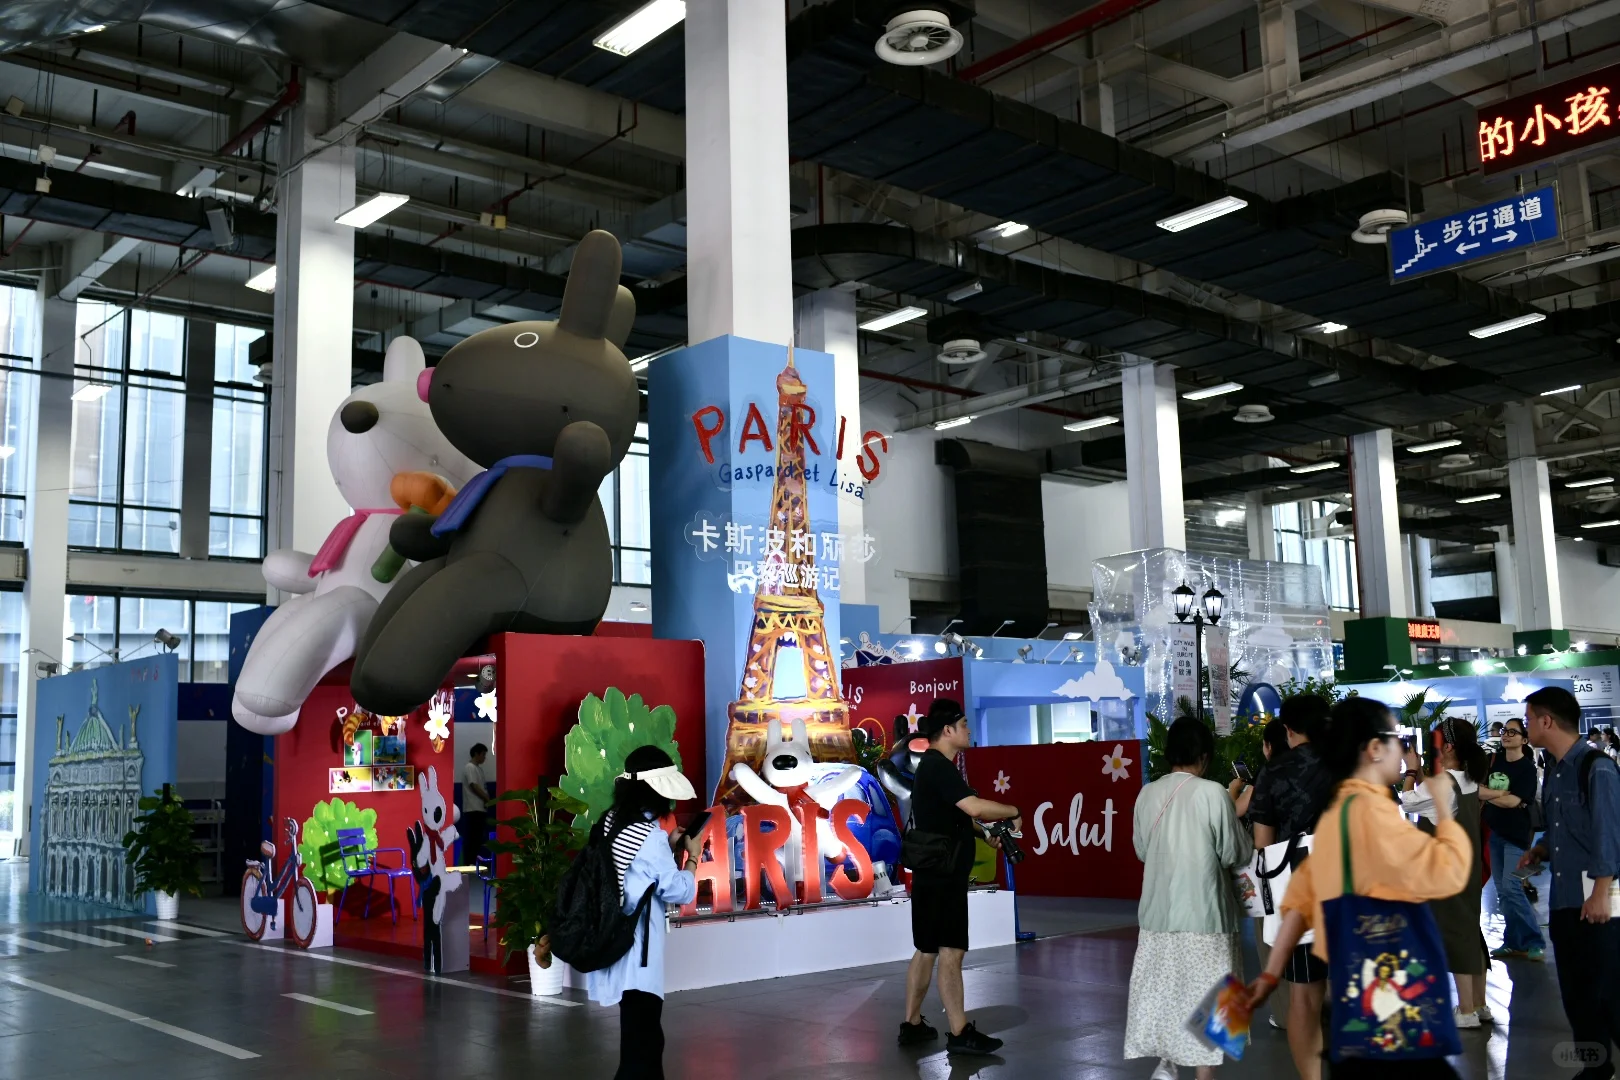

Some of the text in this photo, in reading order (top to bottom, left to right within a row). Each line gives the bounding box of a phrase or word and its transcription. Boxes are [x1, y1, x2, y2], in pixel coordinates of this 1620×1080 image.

[1479, 86, 1620, 162] 的小孩
[1443, 196, 1542, 244] 步行通道
[691, 402, 888, 481] PARIS
[718, 461, 865, 500] Gaspard et Lisa
[692, 519, 876, 563] 卡斯波和丽莎
[1178, 660, 1191, 668] 印象
[840, 684, 864, 704] IS
[910, 677, 959, 699] Bonjour
[1032, 792, 1118, 856] Salut
[659, 798, 875, 917] ARIS
